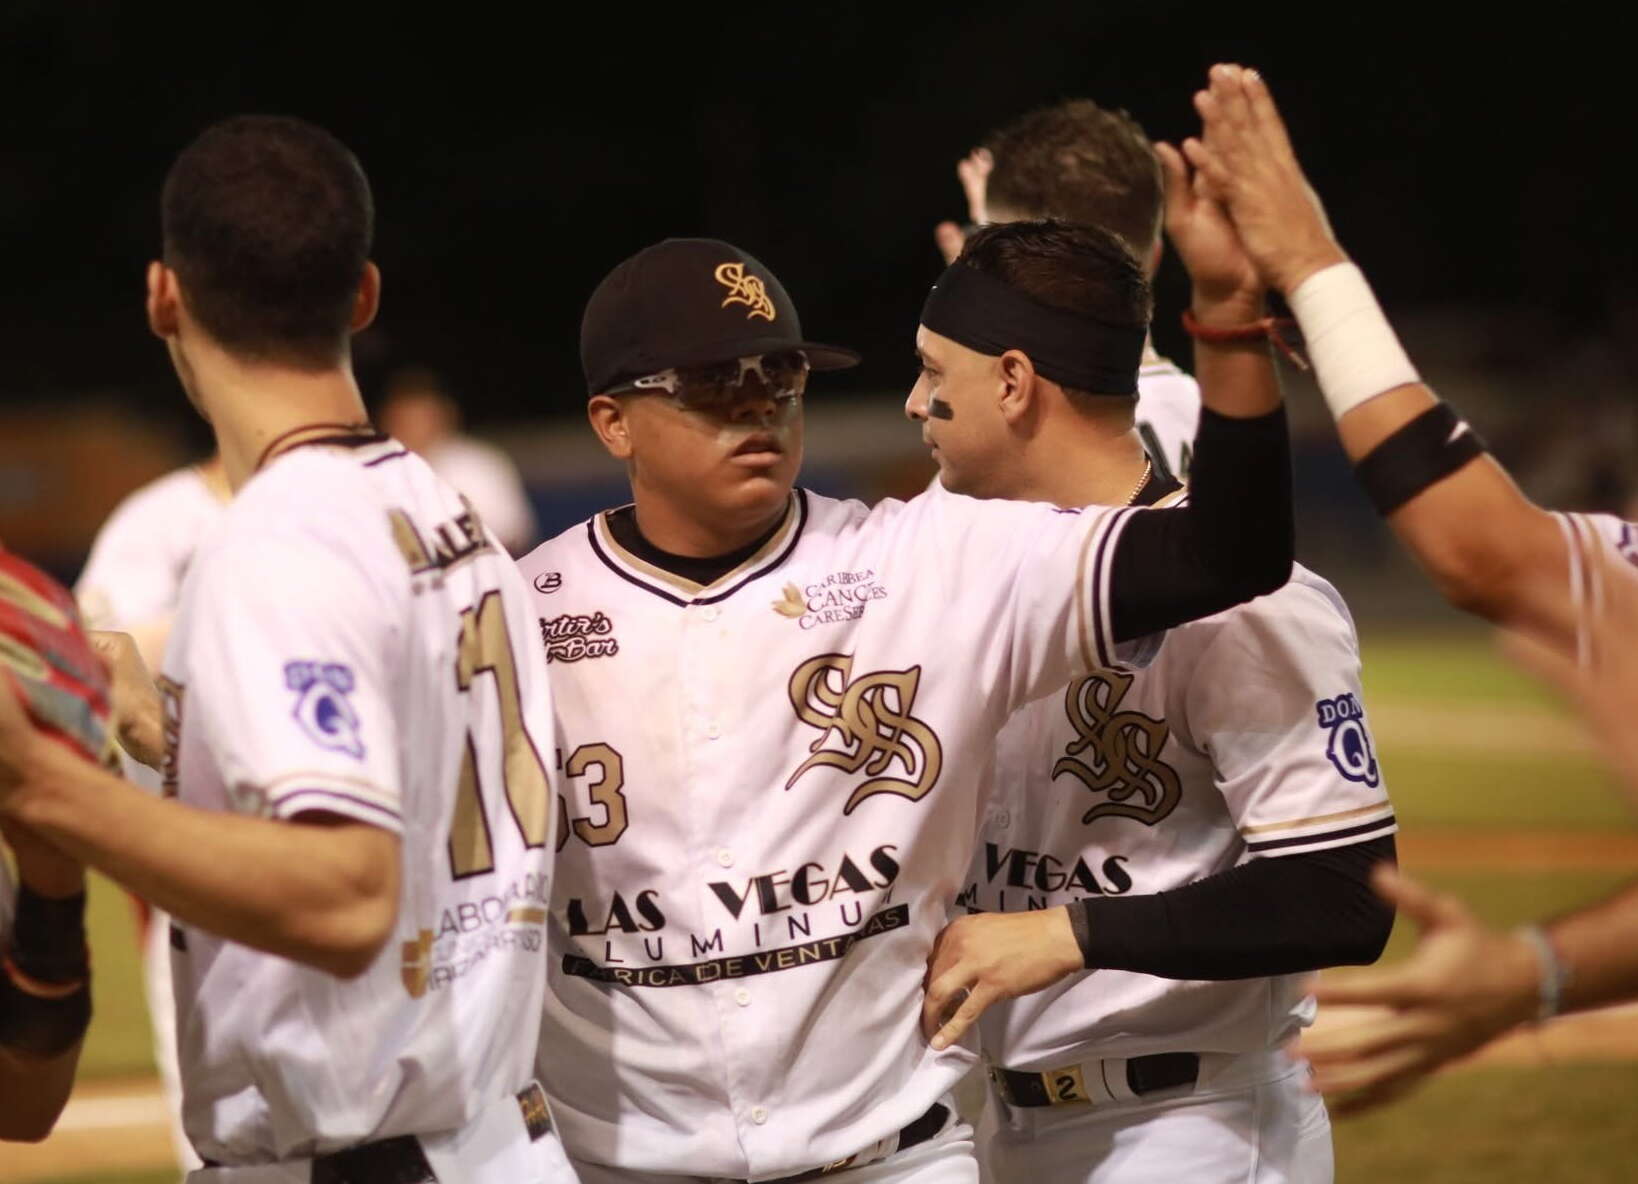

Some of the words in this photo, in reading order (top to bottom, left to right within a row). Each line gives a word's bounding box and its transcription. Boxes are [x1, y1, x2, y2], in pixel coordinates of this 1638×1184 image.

[1330, 719, 1378, 785] Q
[567, 890, 667, 936] LAS
[708, 845, 901, 921] VEGAS
[986, 843, 1132, 895] VEGAS
[605, 888, 895, 964] LUMINU
[1056, 1075, 1078, 1100] 2
